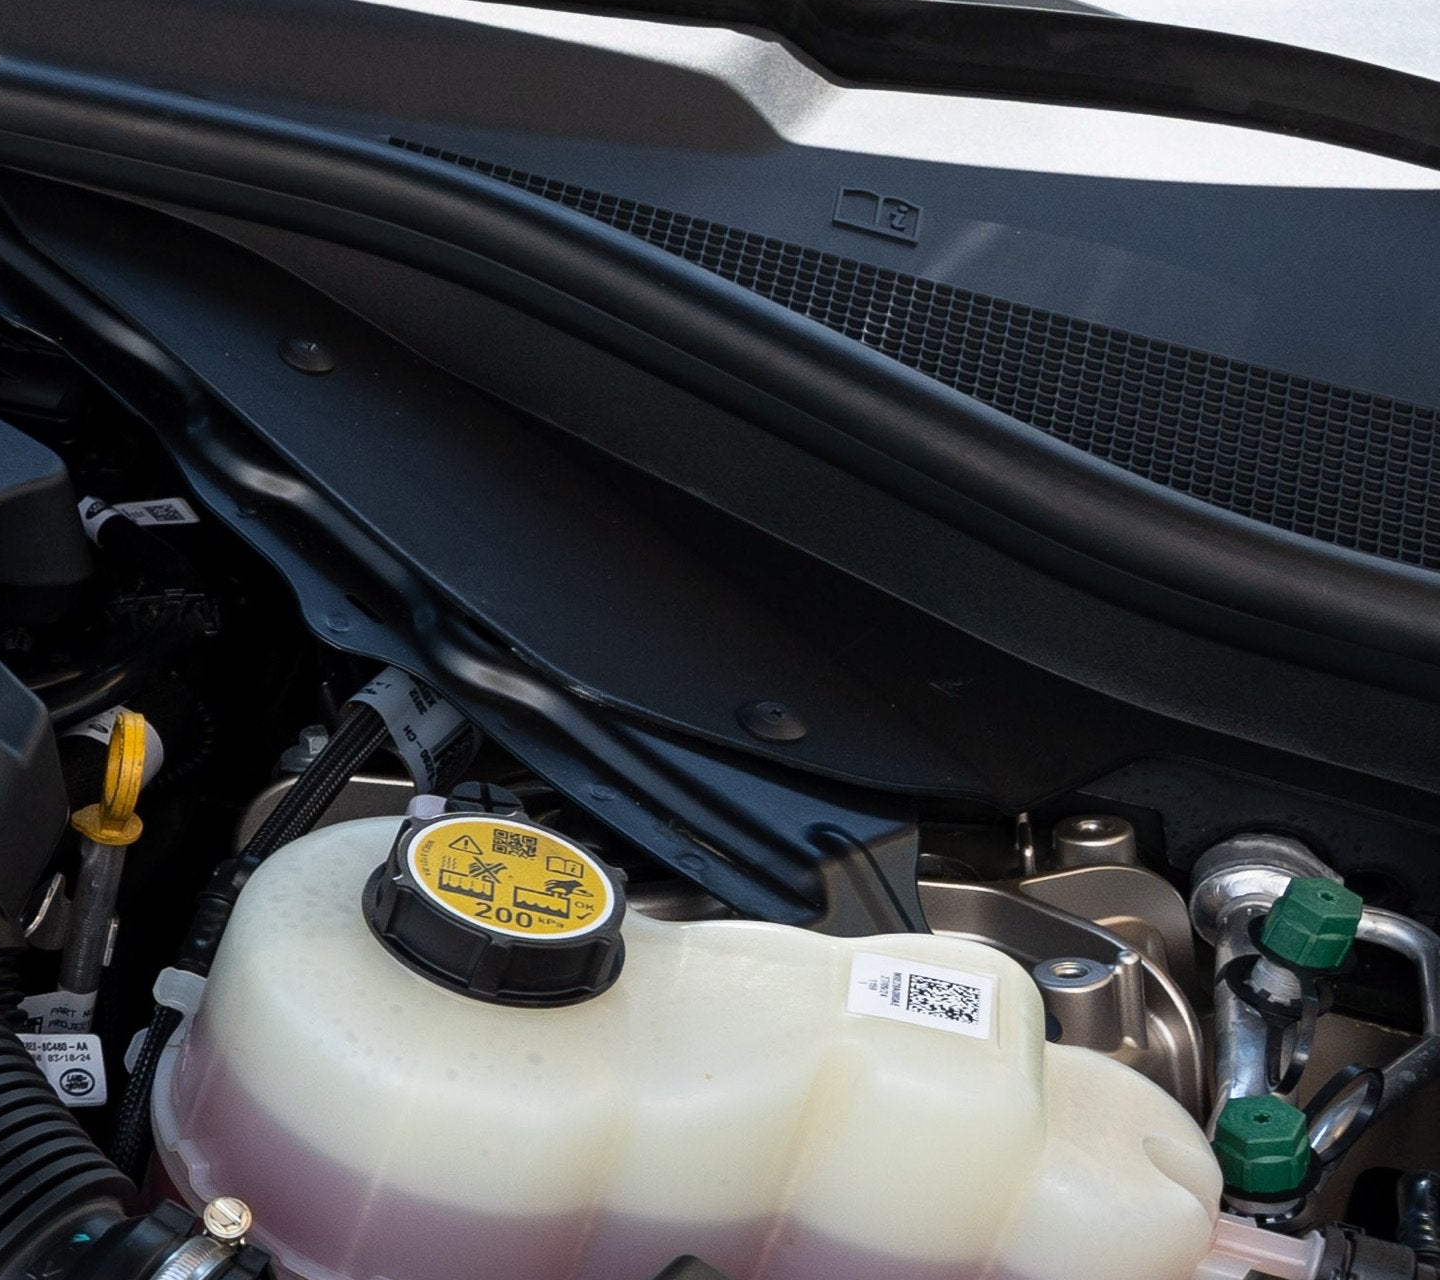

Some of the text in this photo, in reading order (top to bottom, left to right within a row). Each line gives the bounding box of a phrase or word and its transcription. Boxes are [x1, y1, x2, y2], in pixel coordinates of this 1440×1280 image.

[473, 902, 565, 929] 200 kPa
[574, 901, 595, 912] OK
